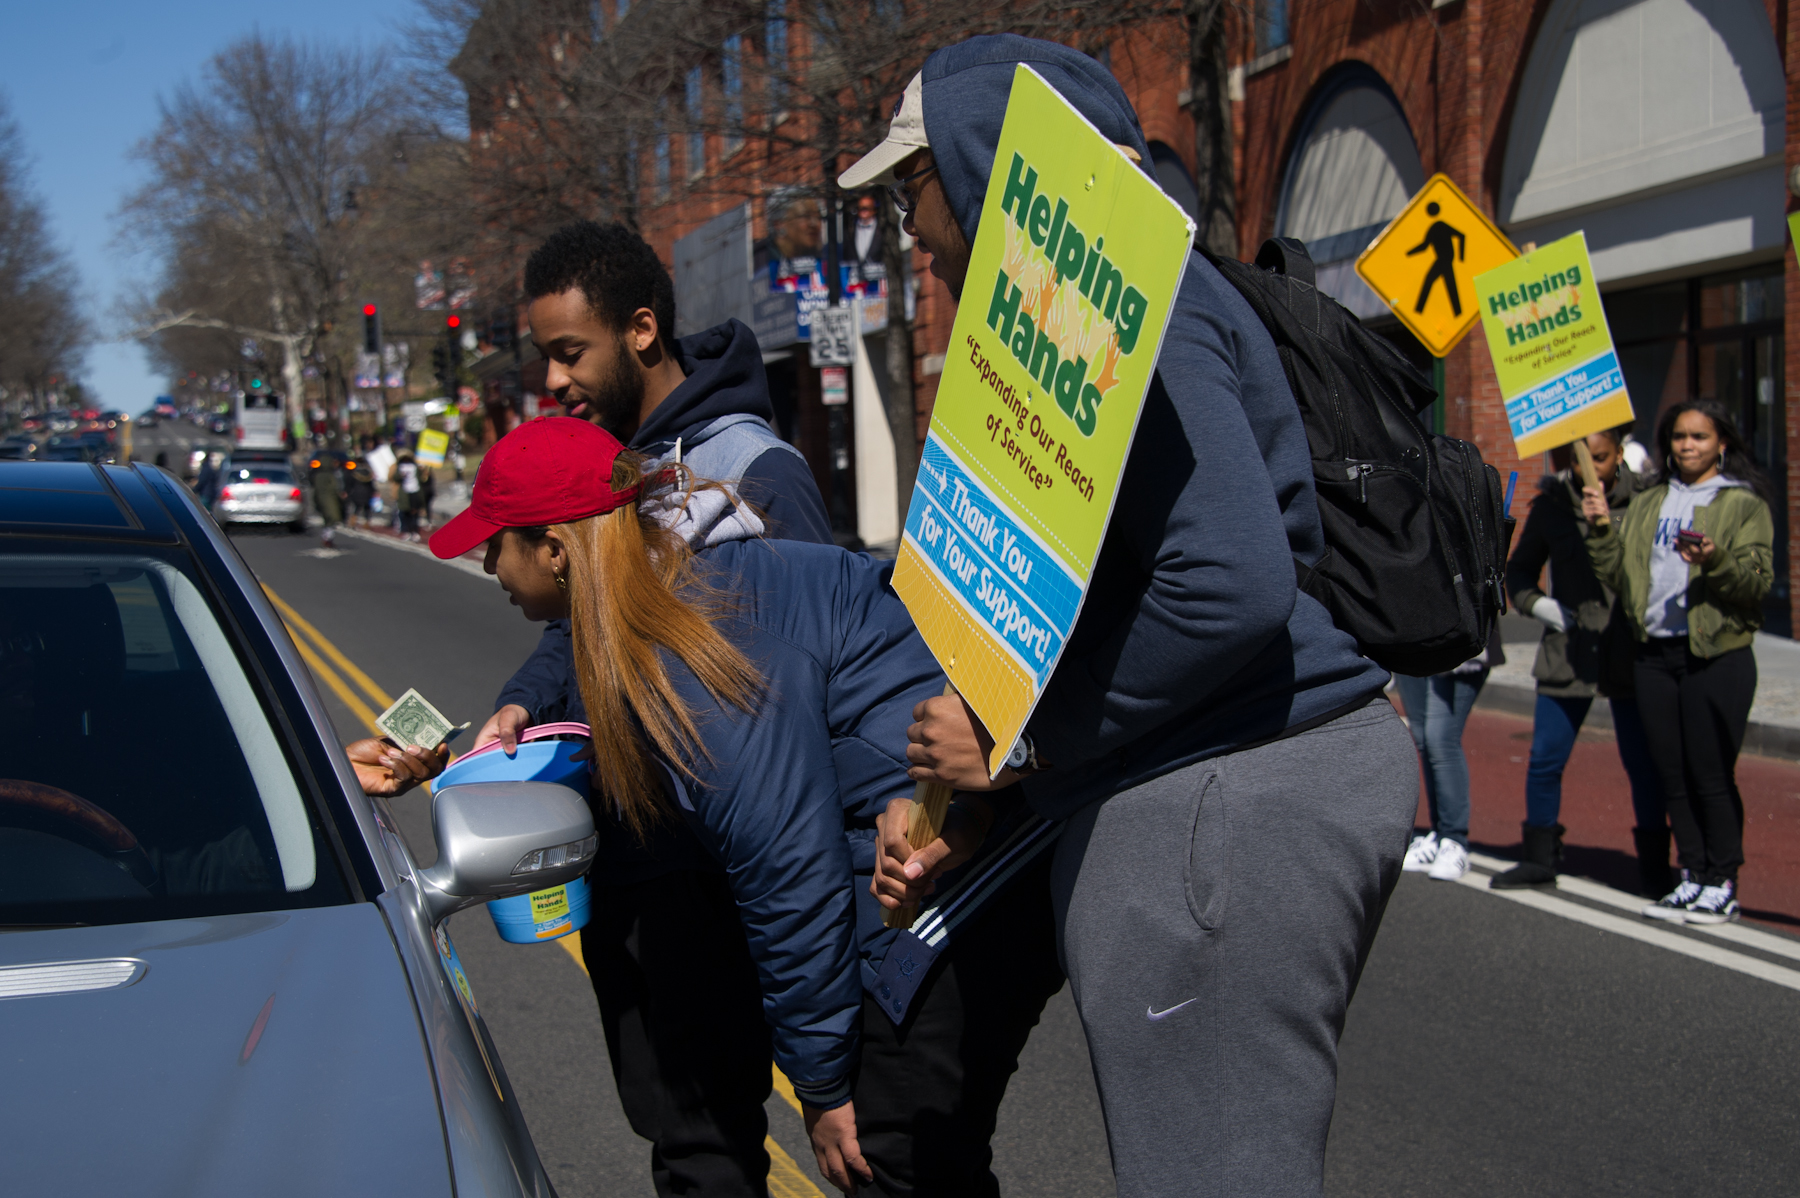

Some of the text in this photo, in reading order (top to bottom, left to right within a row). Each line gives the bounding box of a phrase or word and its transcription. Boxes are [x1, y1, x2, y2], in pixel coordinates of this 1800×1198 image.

[1001, 151, 1148, 355] Helping
[1488, 265, 1581, 316] Helping
[1506, 304, 1582, 346] Hands
[1553, 336, 1568, 347] Our
[1571, 324, 1595, 339] Reach
[818, 338, 849, 359] 25
[986, 268, 1102, 437] Hands
[1532, 358, 1541, 369] of
[1519, 376, 1614, 433] for Your Support!
[1529, 371, 1588, 407] Thank You
[986, 414, 1003, 442] of
[1030, 414, 1055, 453] Our
[1055, 443, 1095, 503] Reach
[950, 477, 1033, 585] Thank You
[917, 504, 1052, 664] for Your Support!
[533, 890, 564, 901] Helping
[537, 900, 563, 909] Hands
